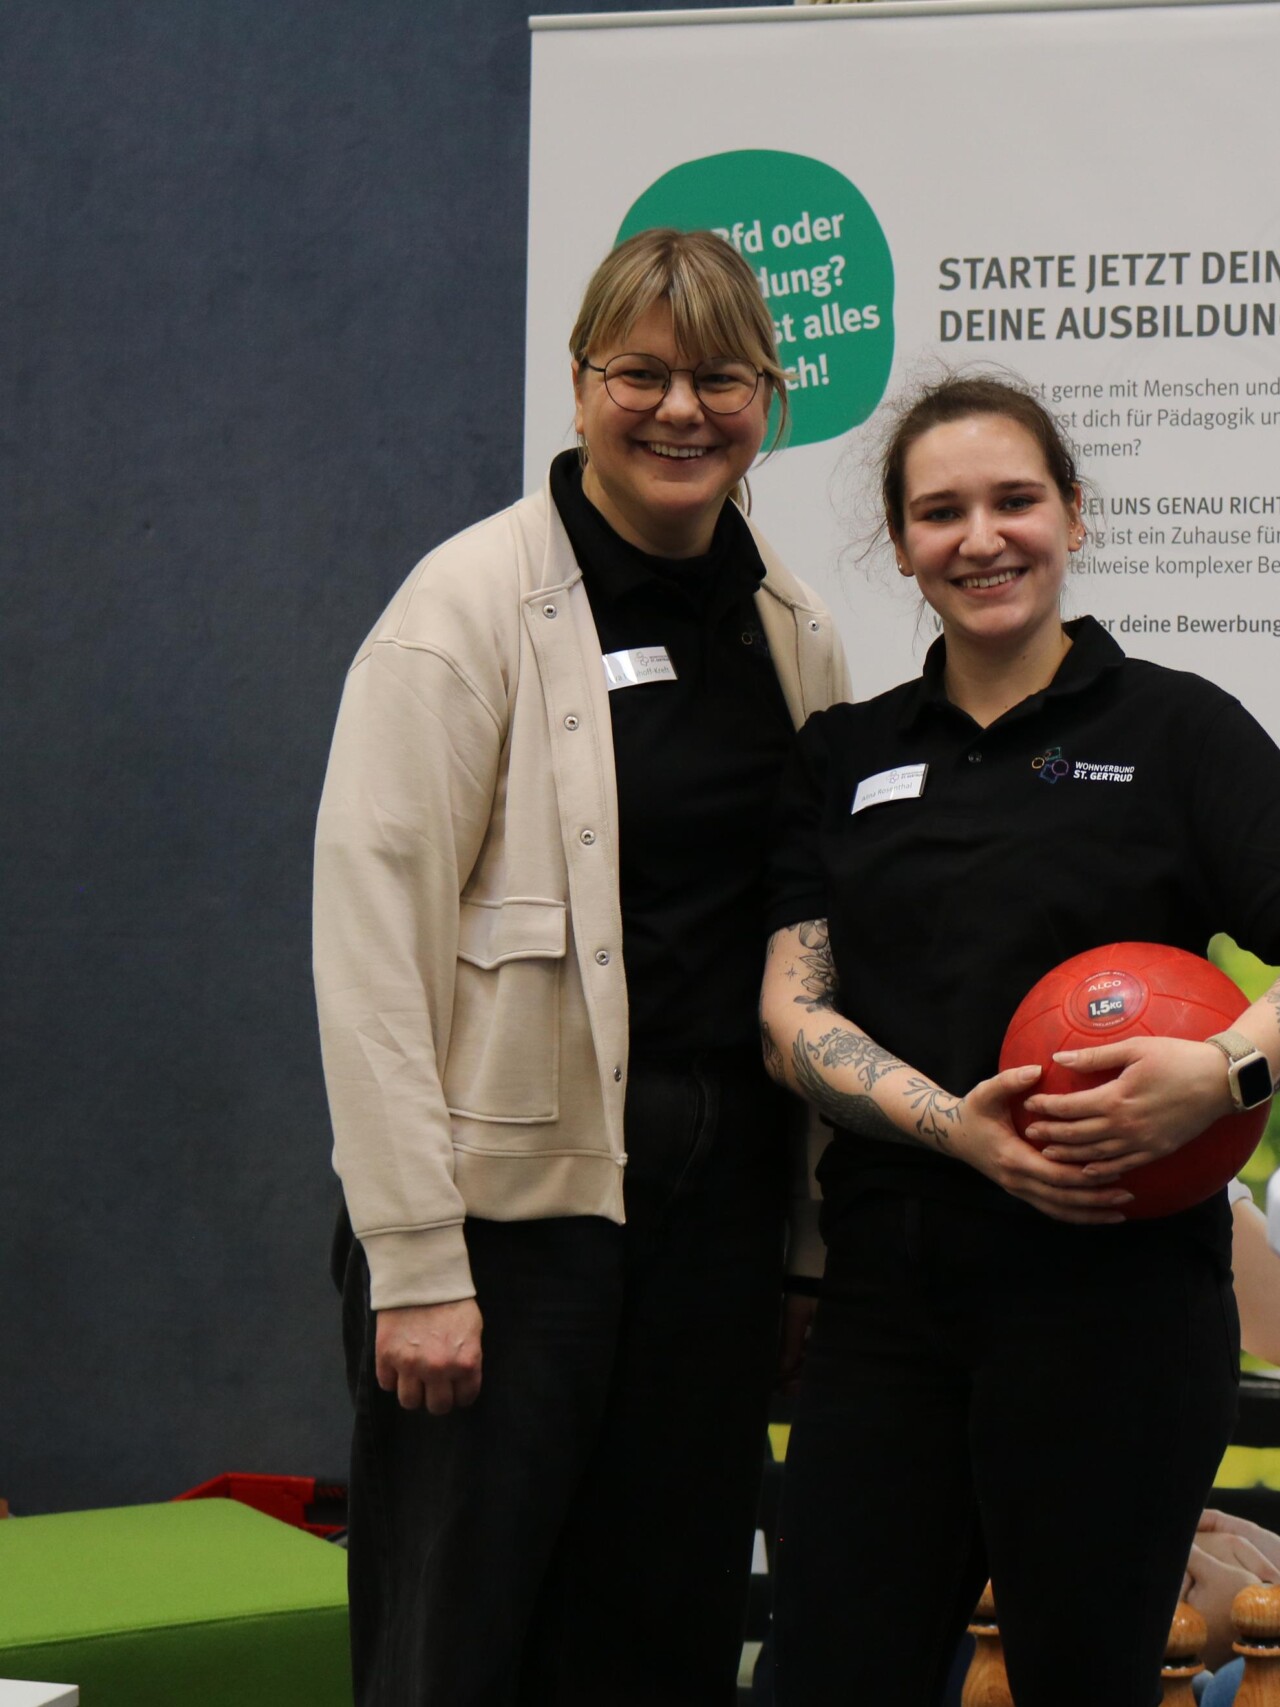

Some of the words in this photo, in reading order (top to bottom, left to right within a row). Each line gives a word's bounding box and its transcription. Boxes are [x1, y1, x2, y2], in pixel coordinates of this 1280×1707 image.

[772, 211, 844, 249] oder
[758, 255, 846, 298] dung?
[938, 254, 1076, 292] STARTE
[1085, 251, 1192, 295] JETZT
[773, 313, 797, 345] st
[803, 302, 881, 340] alles
[940, 307, 1046, 343] DEINE
[783, 353, 830, 391] ch!
[1051, 384, 1104, 404] gerne
[1109, 379, 1138, 398] mit
[1143, 377, 1239, 398] Menschen
[1245, 376, 1280, 397] und
[1082, 408, 1121, 428] dich
[1126, 408, 1153, 428] für
[1157, 406, 1255, 431] Pädagogik
[1110, 496, 1151, 516] UNS
[1156, 496, 1223, 515] GENAU
[1111, 526, 1133, 545] ist
[1138, 526, 1165, 545] ein
[1170, 525, 1252, 545] Zuhause
[1155, 555, 1253, 579] komplexer
[1119, 614, 1172, 633] deine
[1073, 769, 1088, 780] ST.
[1089, 771, 1133, 782] GERTRUD
[1075, 761, 1135, 774] WOHNVERBUND
[1087, 979, 1122, 993] ALCO
